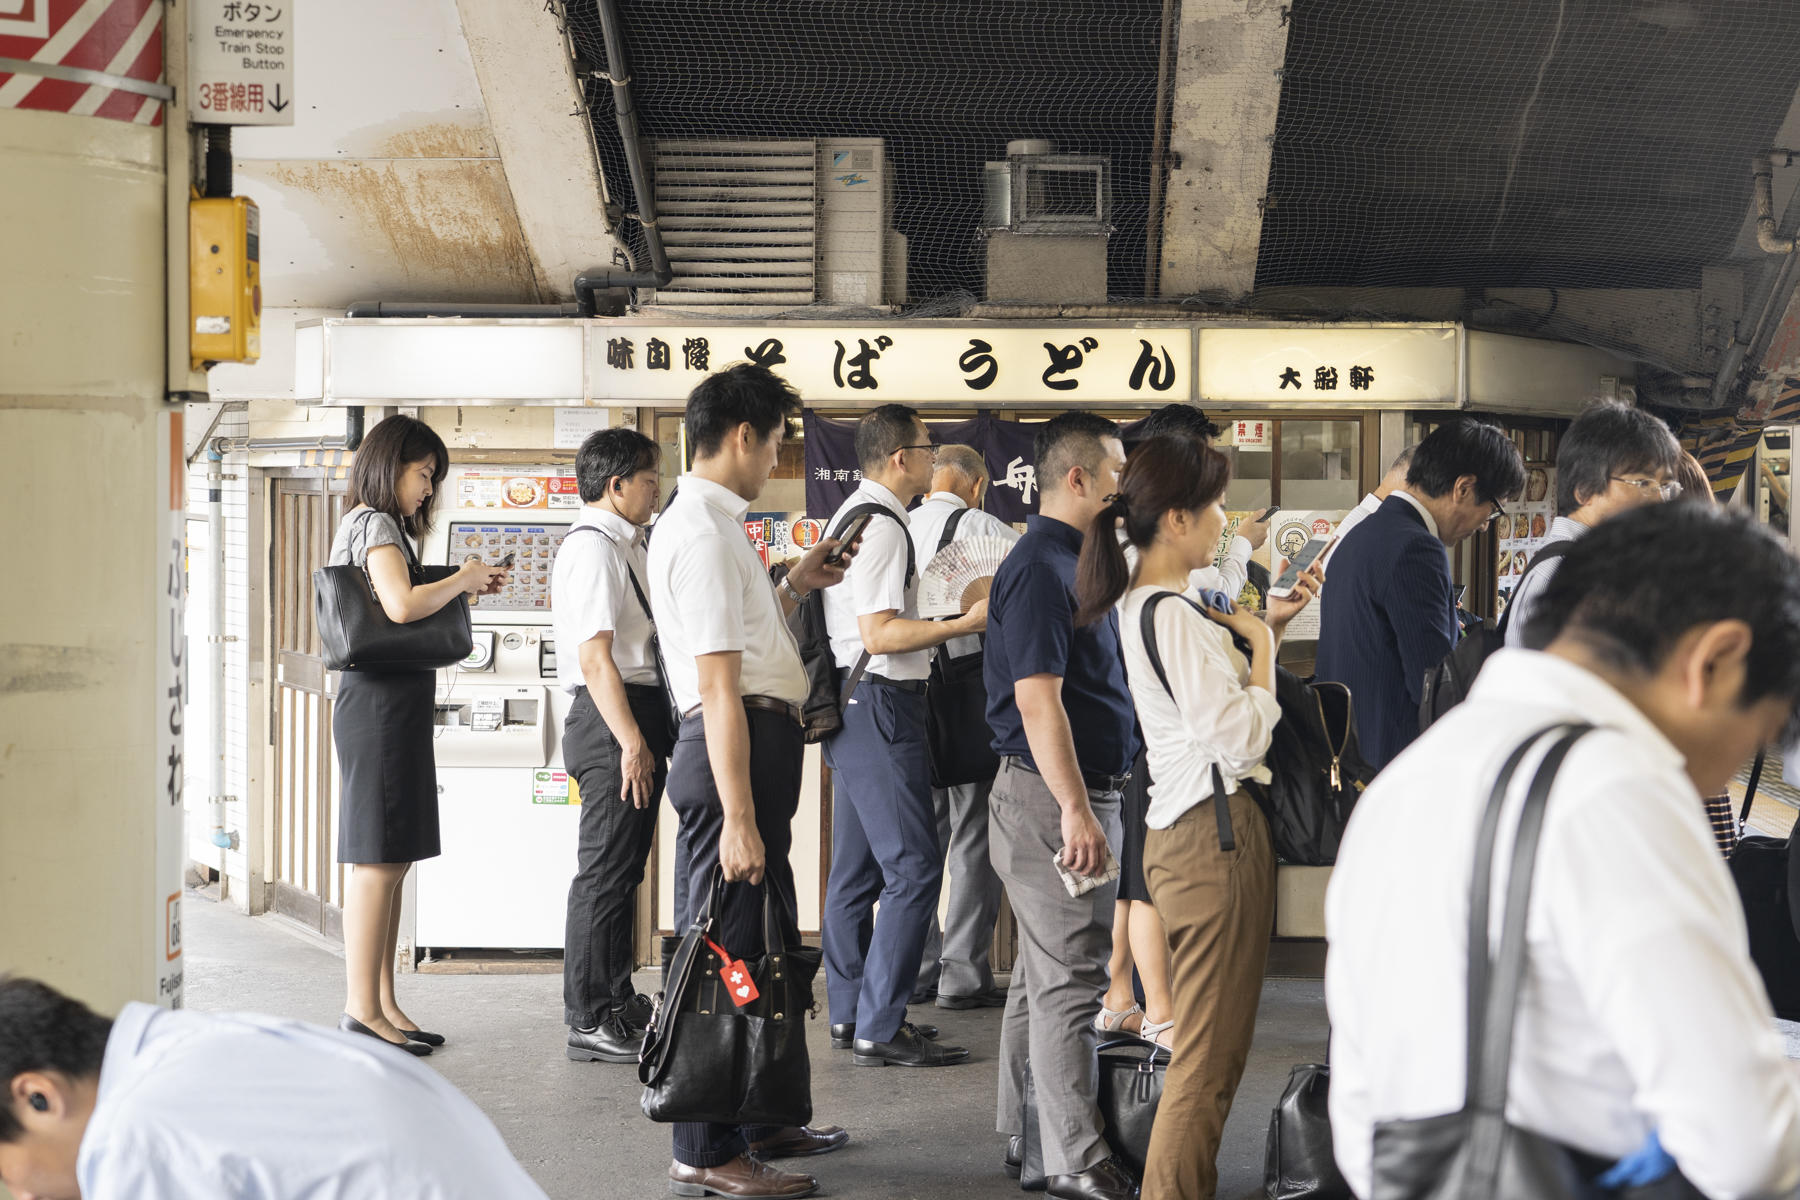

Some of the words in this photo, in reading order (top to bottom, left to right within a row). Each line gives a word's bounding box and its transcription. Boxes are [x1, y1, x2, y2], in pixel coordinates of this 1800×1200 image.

[222, 1, 282, 22] ボタン
[215, 26, 284, 39] Emergency
[219, 41, 251, 54] Train
[256, 43, 285, 55] Stop
[242, 57, 285, 70] Button
[199, 82, 264, 112] 3番線用
[1279, 366, 1374, 390] 大船軒
[168, 538, 183, 806] ふじさわ
